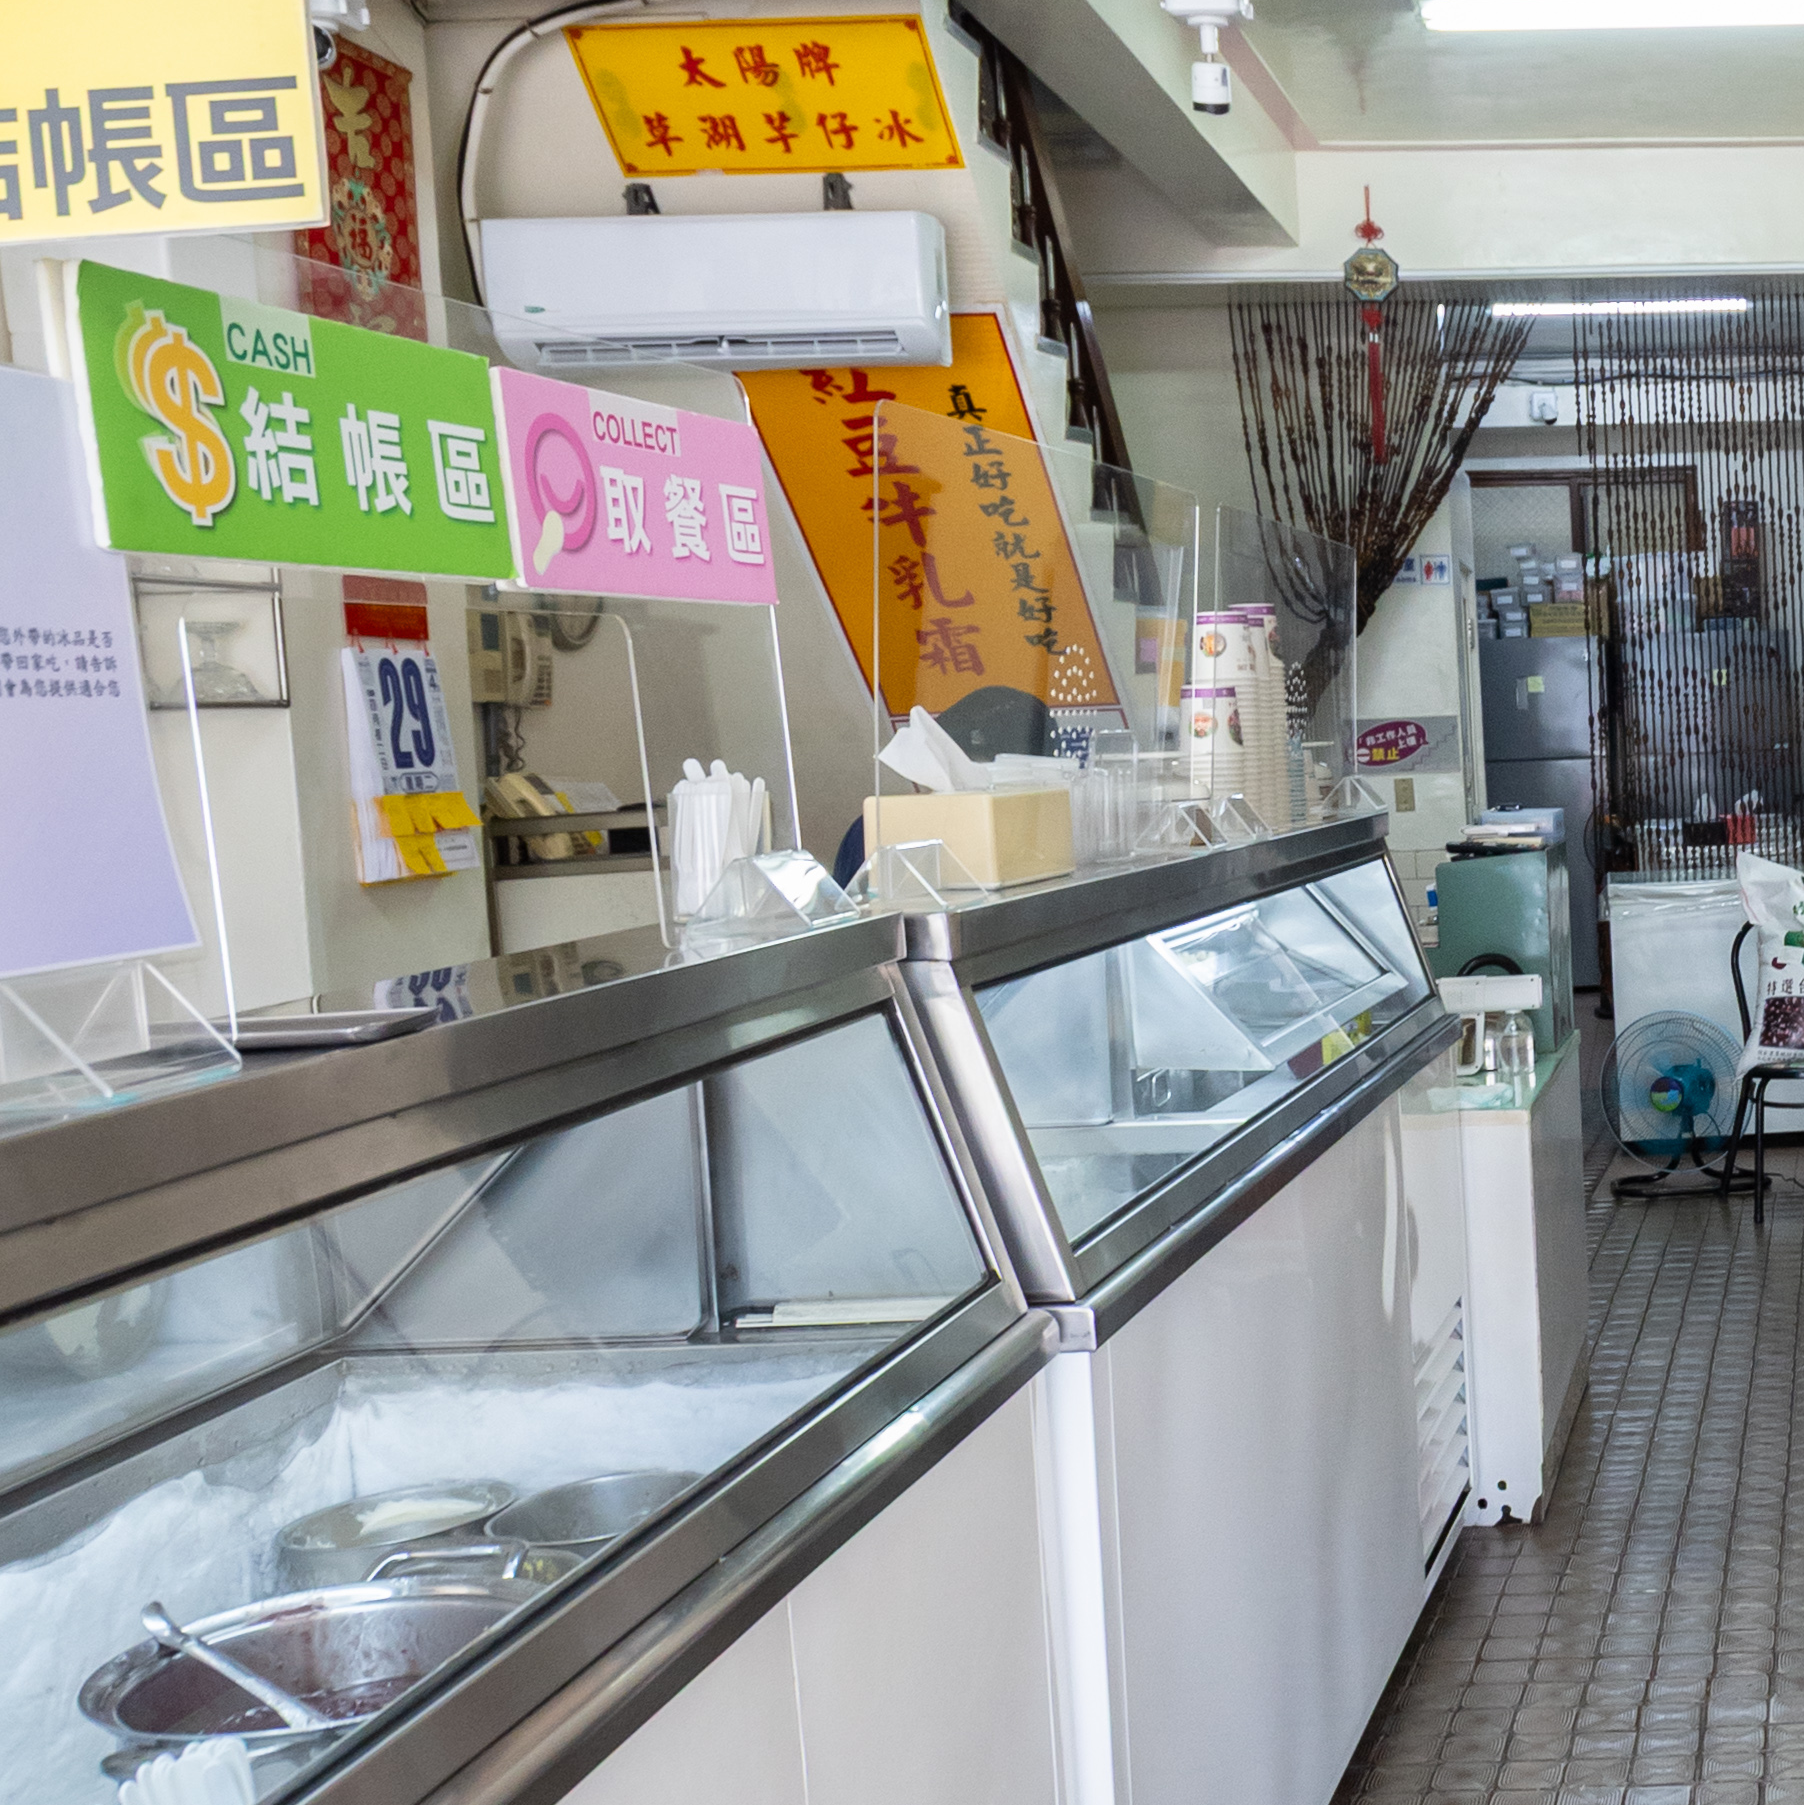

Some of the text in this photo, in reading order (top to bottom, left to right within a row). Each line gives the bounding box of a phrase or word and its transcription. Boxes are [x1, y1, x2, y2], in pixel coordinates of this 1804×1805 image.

[676, 40, 841, 89] 太陽牌
[640, 108, 926, 157] 草湖芋仔冰
[225, 319, 312, 378] CASH
[239, 385, 496, 524] 結帳區
[592, 409, 678, 458] COLLECT
[599, 464, 765, 565] 取餐區
[800, 368, 987, 676] 紅豆牛乳霜
[945, 384, 1070, 659] 真正好吃就是好吃
[0, 678, 120, 698] 會為您提供適合您
[377, 656, 437, 769] 29
